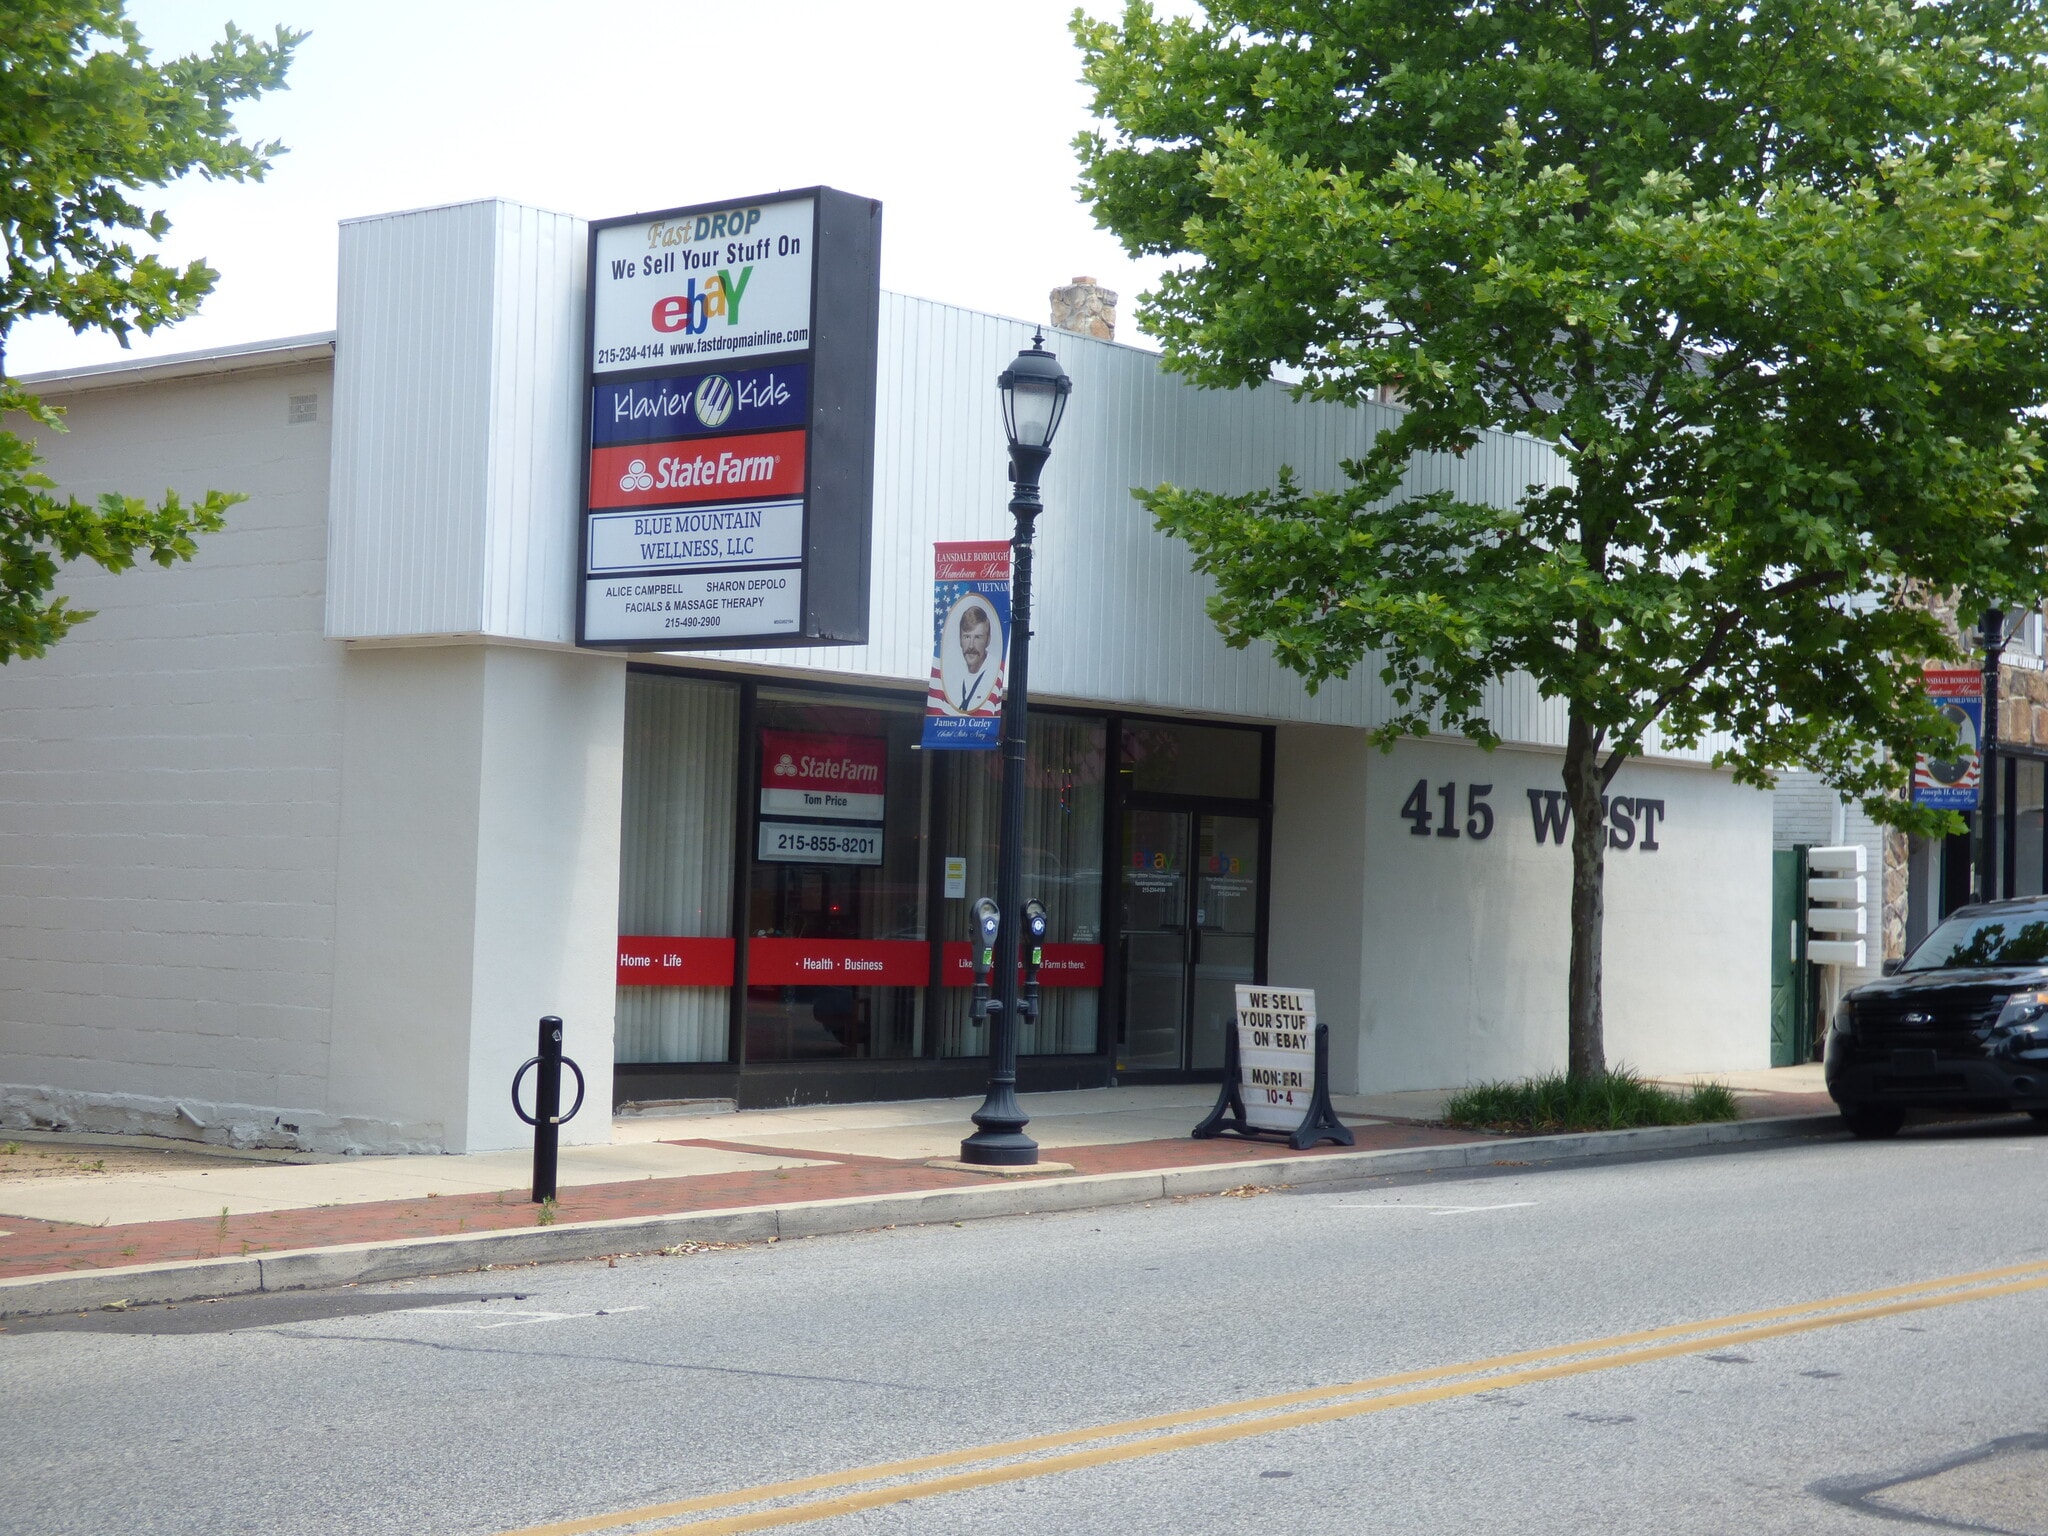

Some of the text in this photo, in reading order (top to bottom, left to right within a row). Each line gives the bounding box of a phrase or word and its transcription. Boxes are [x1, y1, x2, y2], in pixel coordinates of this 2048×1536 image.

[612, 234, 801, 280] We Sell Your Stuff On
[598, 327, 808, 364] 215-234-4144 www.fastdropmainline.com
[614, 373, 791, 423] Klavier Kids
[634, 511, 762, 536] BLUE MOUNTAIN
[640, 537, 754, 560] WELLNESS, LLC
[937, 551, 1009, 563] LANSDALE BOROUGH
[936, 563, 1010, 579] Hometown Heroes
[606, 578, 786, 597] ALICE CAMPBELL SHARON DEPOLO
[977, 582, 1010, 592] VIETNAM
[625, 597, 765, 613] FACIALS & MASSAGE THERAPY
[665, 616, 721, 628] 215-490-2900
[934, 718, 992, 730] James D. Curley
[804, 794, 848, 807] Tom Price
[1921, 788, 1942, 797] Joseph
[1952, 788, 1972, 798] Curley
[1401, 779, 1495, 840] 415
[778, 834, 875, 854] 215-855-8201
[620, 953, 682, 967] Home Life
[803, 957, 883, 971] Health Business
[959, 959, 973, 968] Like
[1045, 960, 1060, 969] Farm
[1061, 960, 1067, 968] is
[1250, 992, 1303, 1011] WE SELL
[1240, 1011, 1306, 1030] YOUR STUF
[1254, 1031, 1307, 1050] ON EBAY
